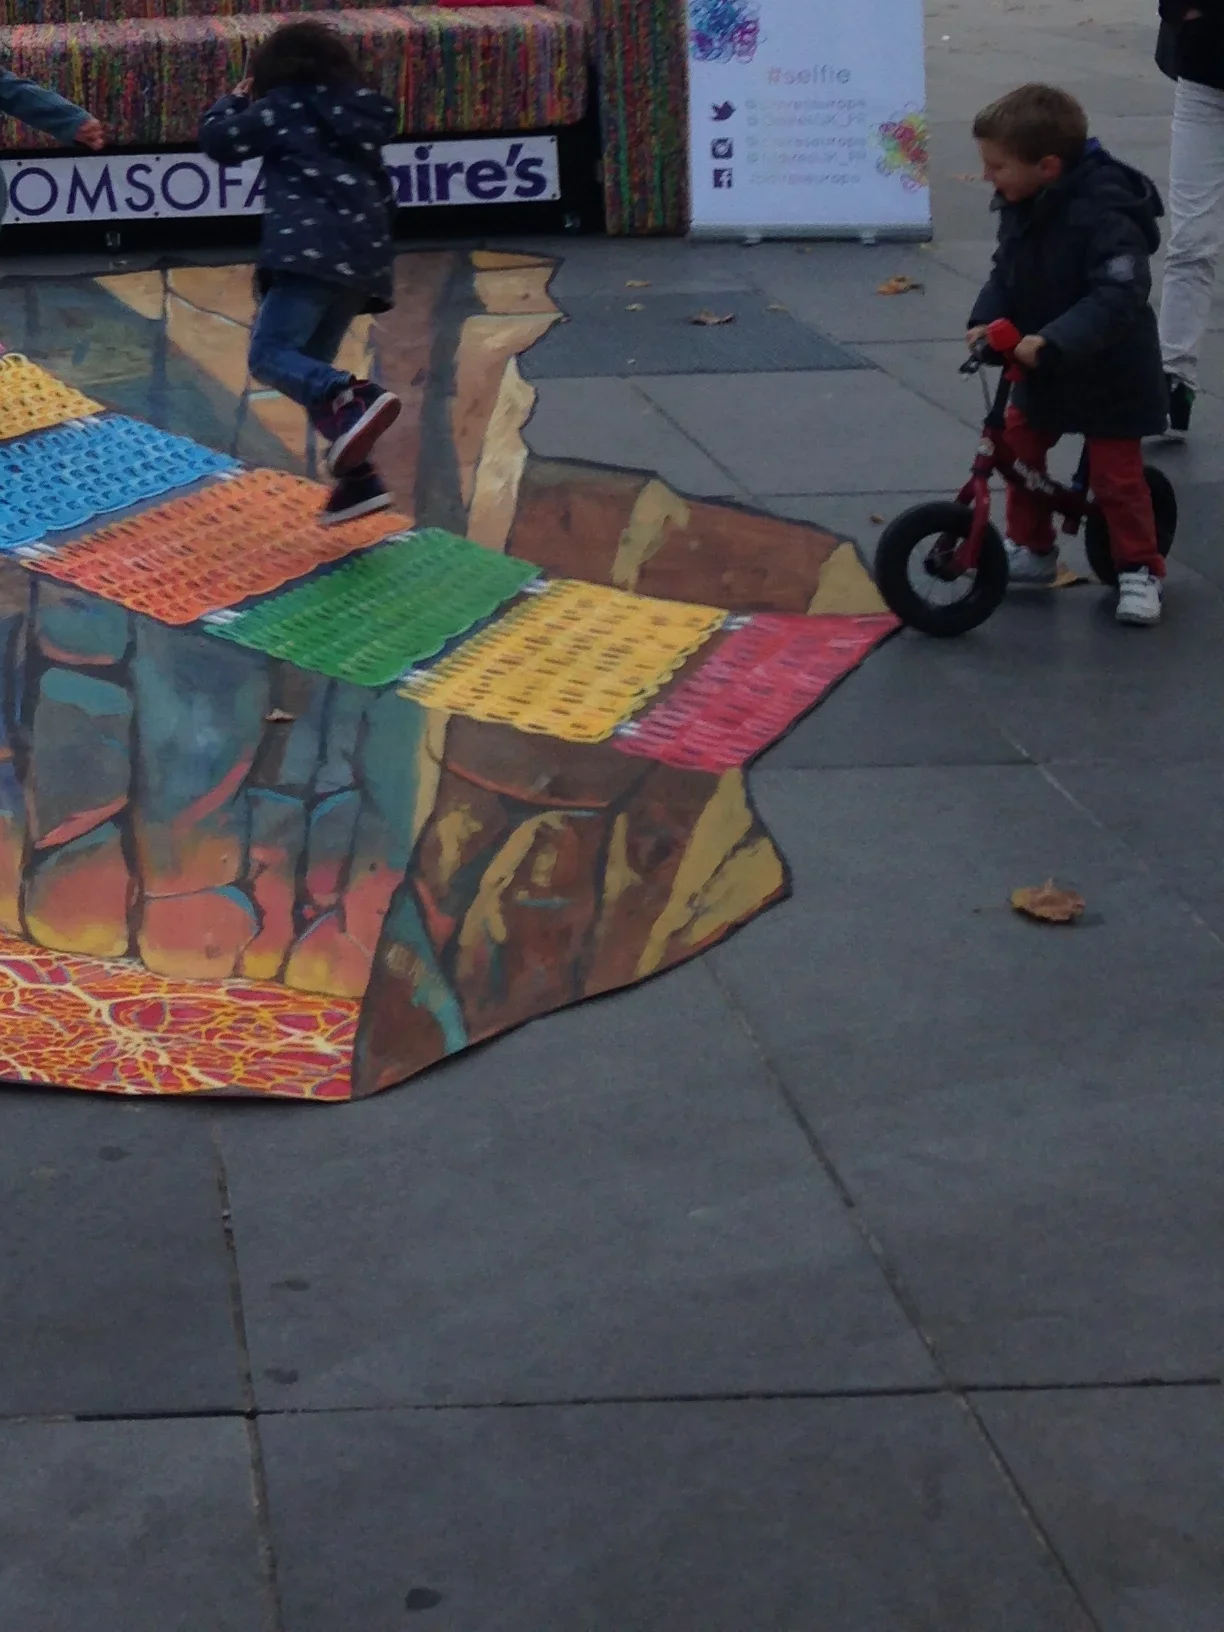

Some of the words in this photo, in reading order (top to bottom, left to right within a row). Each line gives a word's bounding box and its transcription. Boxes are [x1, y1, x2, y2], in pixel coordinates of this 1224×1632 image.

[767, 64, 852, 85] #selfie
[9, 161, 267, 217] OMSOF
[385, 143, 548, 204] aire's
